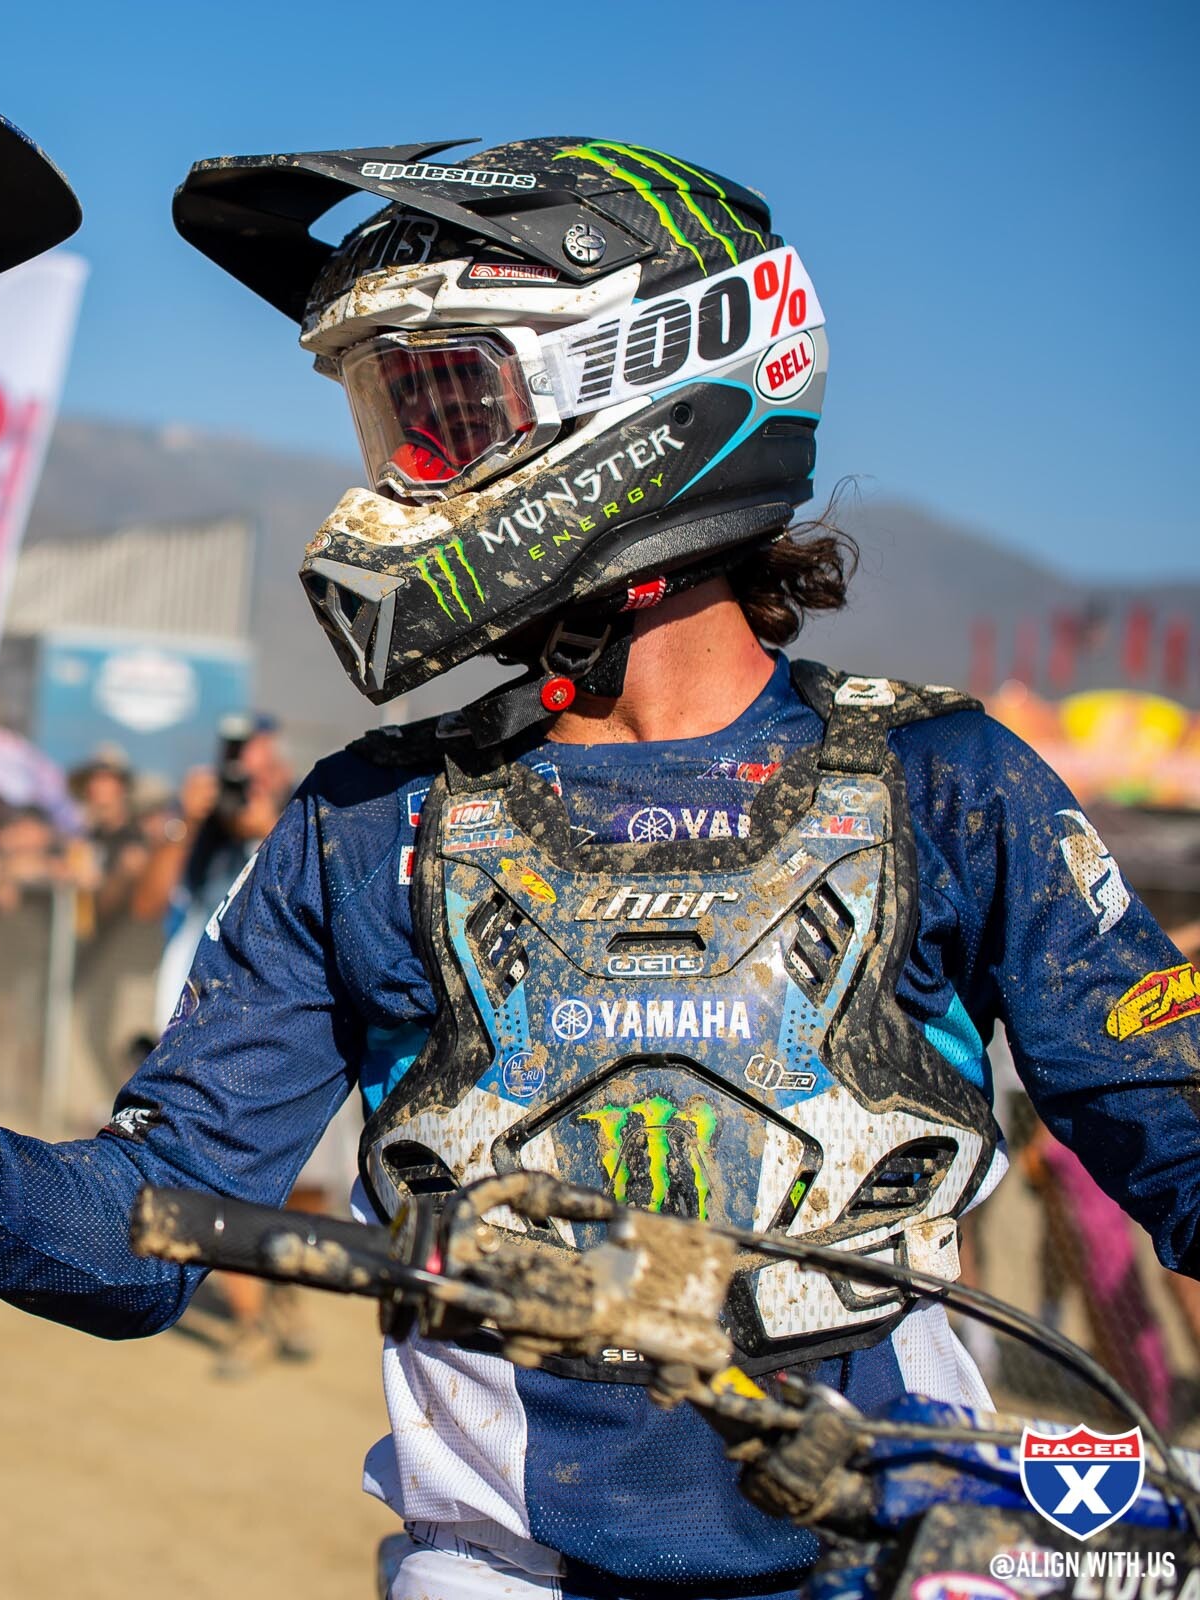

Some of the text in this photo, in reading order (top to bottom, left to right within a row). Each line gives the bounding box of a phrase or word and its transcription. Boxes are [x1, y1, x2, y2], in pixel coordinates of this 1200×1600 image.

[361, 162, 537, 189] apdesigns
[498, 266, 555, 280] SPHERICAL
[568, 254, 808, 405] 100%
[765, 341, 812, 392] BELL
[477, 424, 685, 554] MONSTER
[528, 472, 664, 560] ENERGY
[574, 885, 740, 922] thor
[608, 955, 704, 975] OGIO
[600, 1001, 751, 1038] YAMAHA
